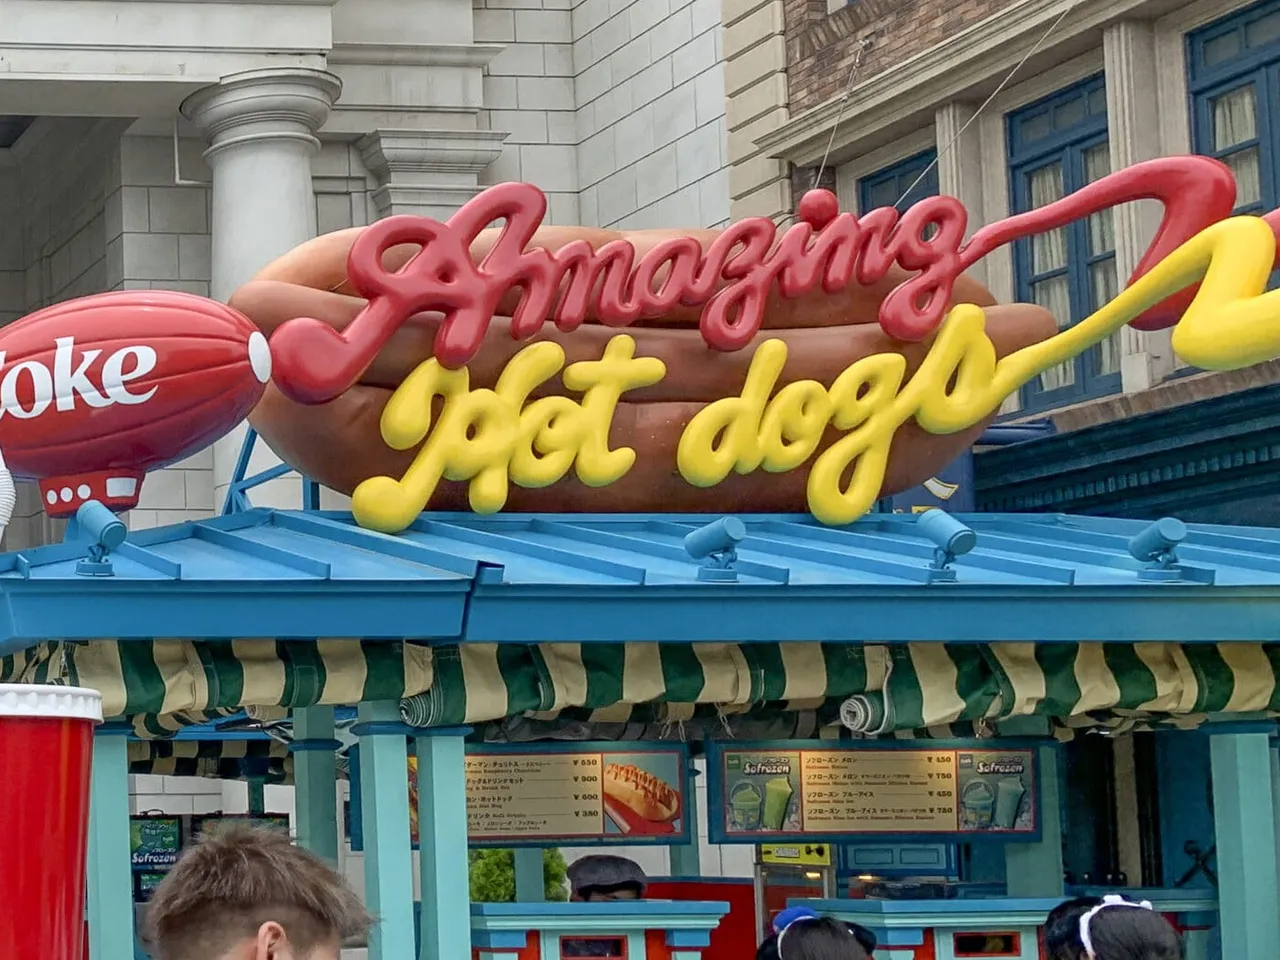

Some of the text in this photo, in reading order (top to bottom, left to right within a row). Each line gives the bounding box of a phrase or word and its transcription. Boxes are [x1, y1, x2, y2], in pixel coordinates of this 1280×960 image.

[744, 762, 790, 774] Sofrozen
[977, 762, 1023, 773] Sofrozen
[131, 852, 177, 864] Sofrozen
